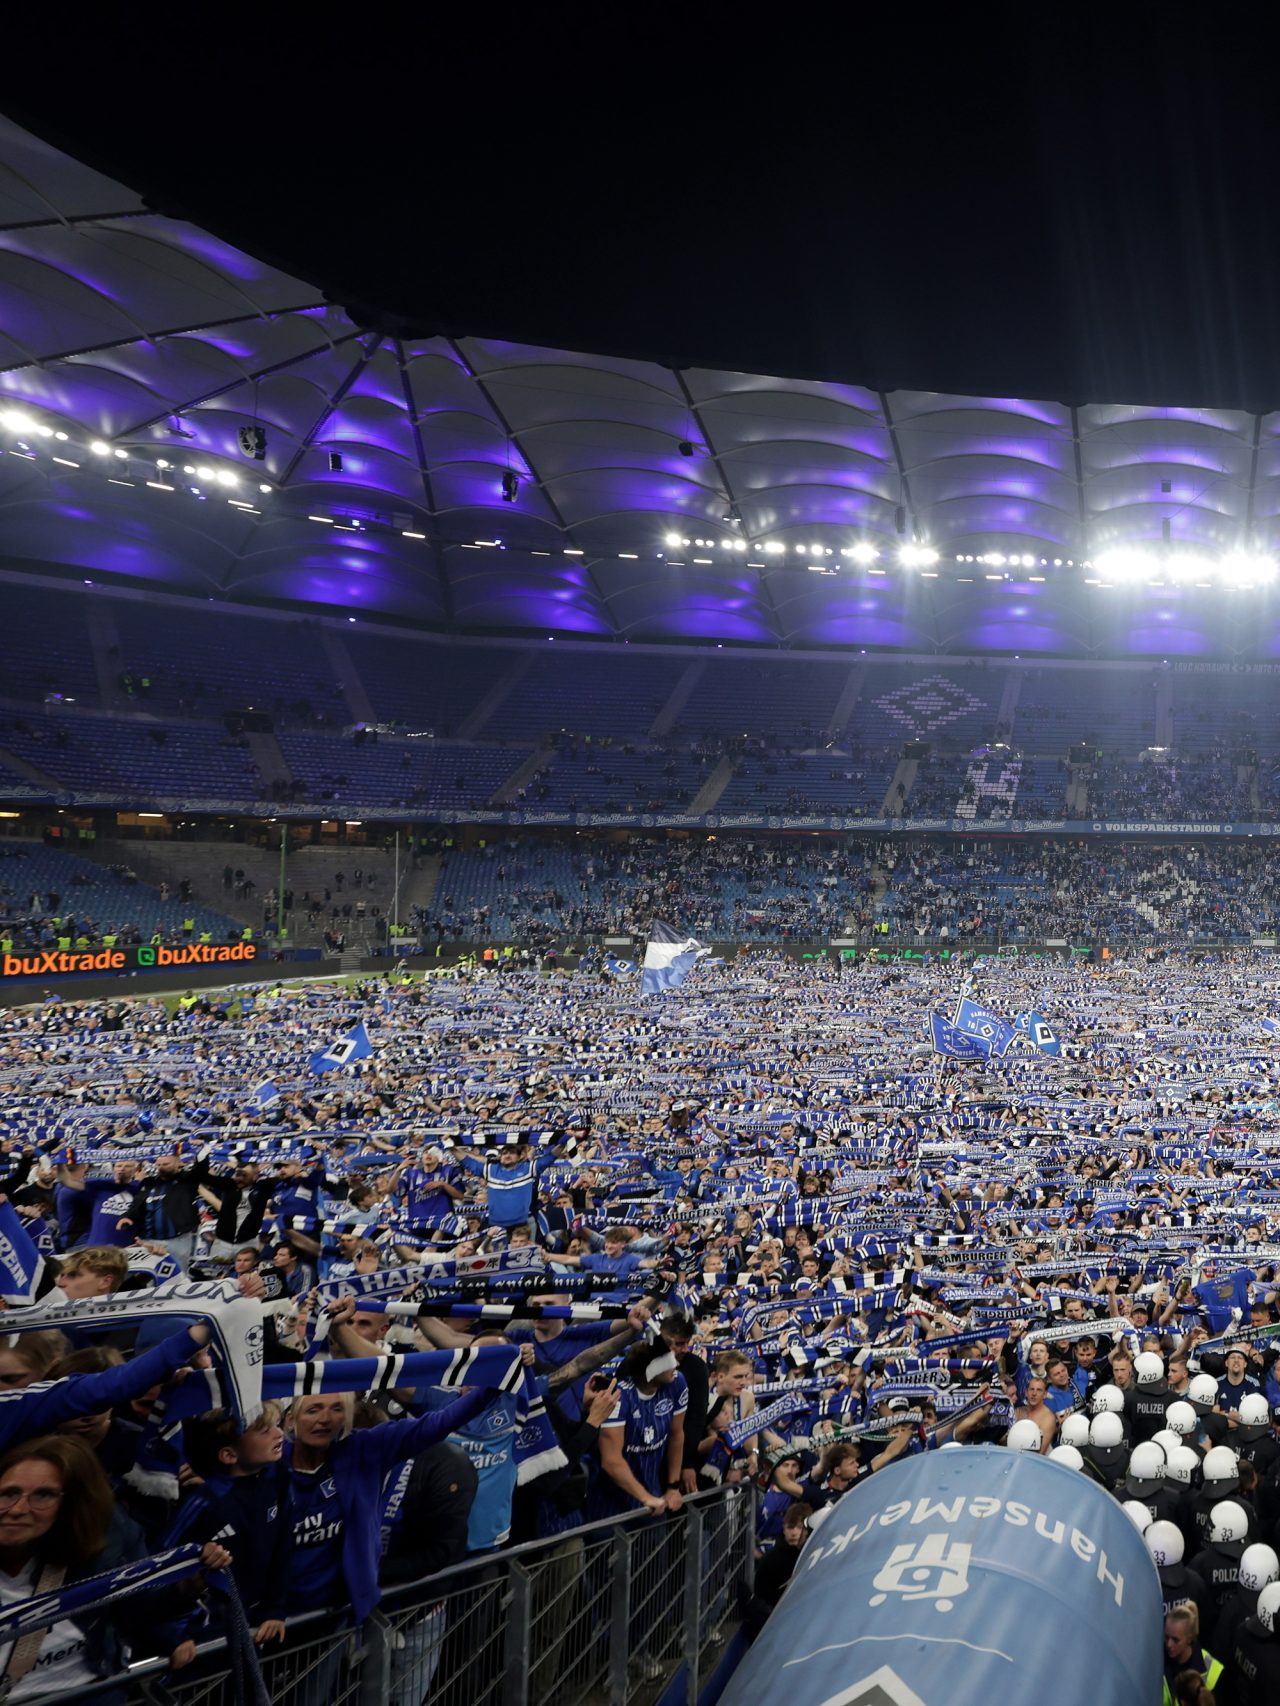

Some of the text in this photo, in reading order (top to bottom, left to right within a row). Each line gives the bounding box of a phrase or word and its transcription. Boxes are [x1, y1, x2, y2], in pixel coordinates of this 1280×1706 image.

[1105, 823, 1221, 833] VOLKSPARKSTADION
[157, 942, 256, 966] buXtrade
[3, 949, 125, 976] buXtrade
[822, 1147, 890, 1156] HAMBURGER SV
[985, 1209, 1055, 1227] HAMBURGER
[936, 1251, 1007, 1266] HAMBURGER
[45, 1304, 127, 1320] SEIT 1953
[1141, 1372, 1158, 1382] A22
[1137, 1403, 1164, 1414] POLIZEI
[728, 1403, 784, 1441] HAMBURGER
[1253, 1415, 1269, 1424] A22
[1168, 1423, 1184, 1432] A22
[1177, 1469, 1188, 1479] 33
[1221, 1528, 1233, 1539] 33
[1154, 1551, 1166, 1562] 33
[1212, 1569, 1239, 1583] POLIZ
[1239, 1569, 1258, 1586] A22
